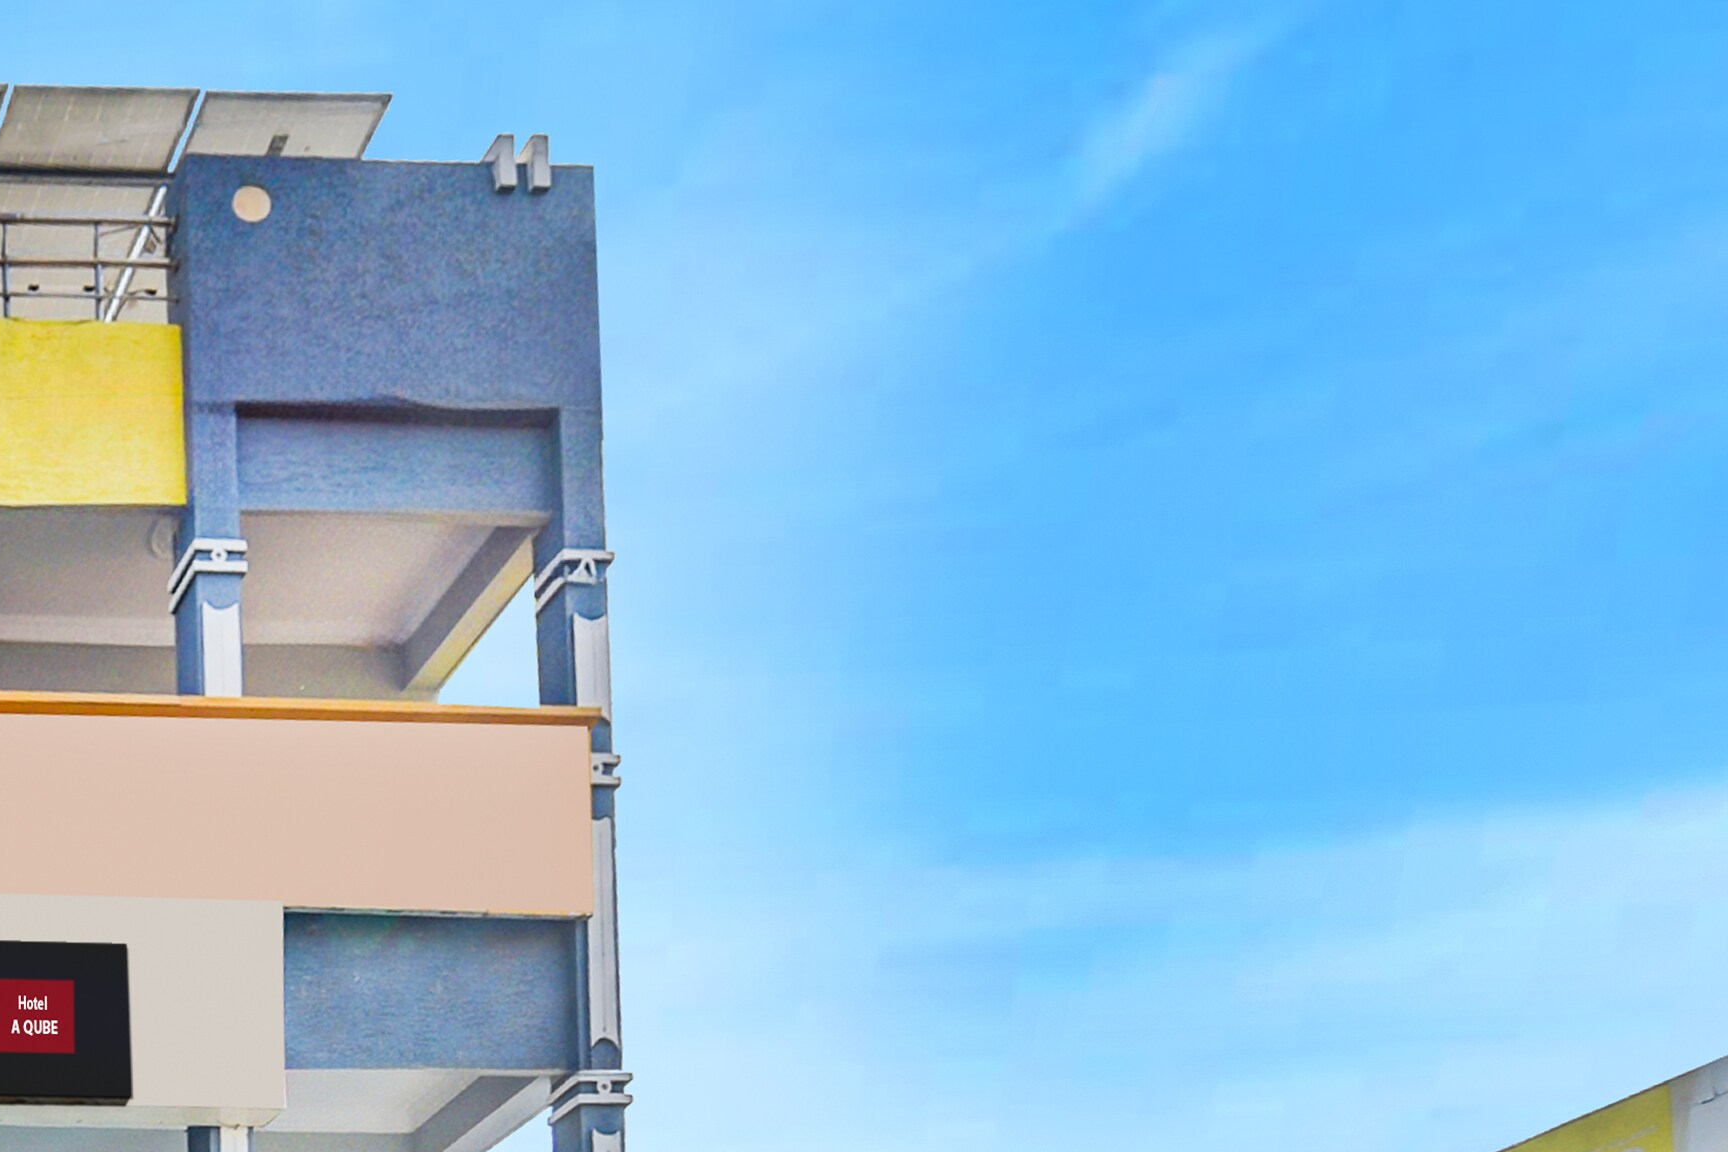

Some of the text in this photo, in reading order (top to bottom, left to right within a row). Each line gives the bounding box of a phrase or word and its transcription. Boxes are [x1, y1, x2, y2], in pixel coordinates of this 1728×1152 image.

[17, 995, 48, 1011] Hotel
[11, 1019, 59, 1036] A QUBE
